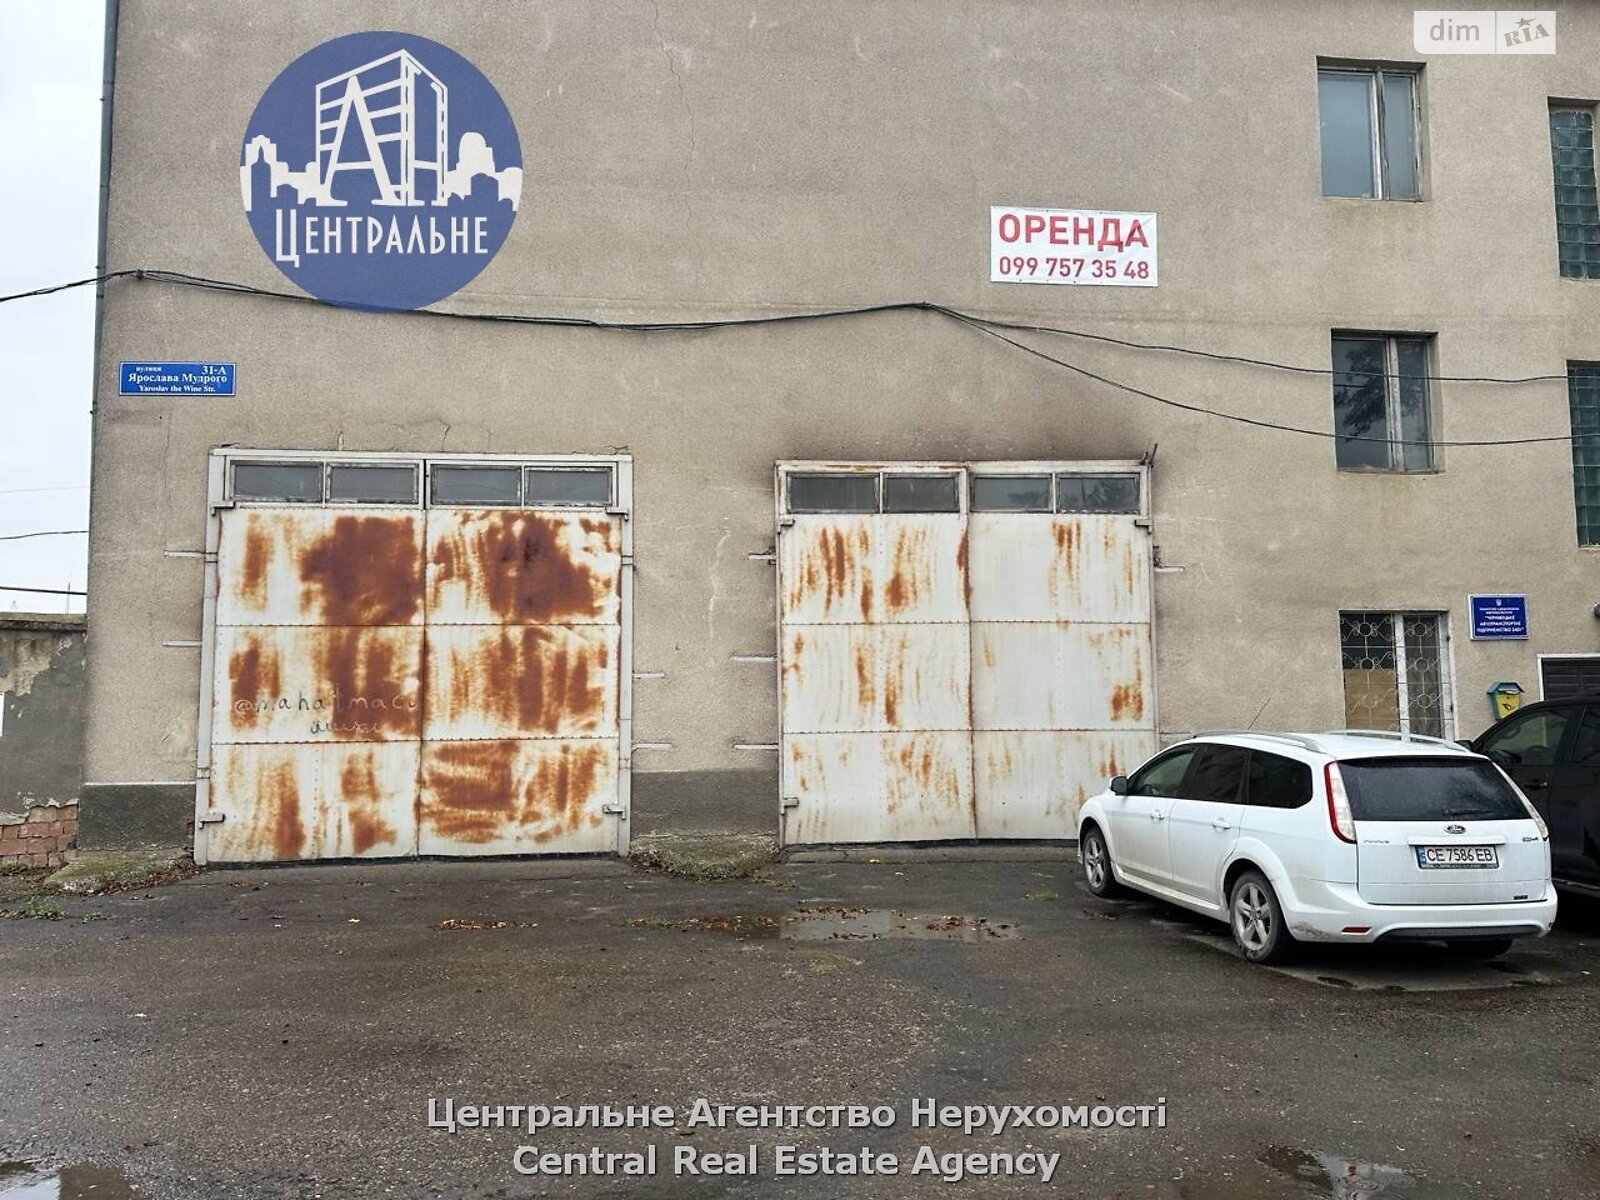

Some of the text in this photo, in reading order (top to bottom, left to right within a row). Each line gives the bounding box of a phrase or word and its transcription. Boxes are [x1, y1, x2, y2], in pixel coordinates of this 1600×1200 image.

[999, 213, 1149, 253] ОРЕНДА
[999, 256, 1149, 279] 099 757 35 48
[201, 365, 227, 375] 31-А
[128, 373, 228, 384] Ярослава Мудрого
[1427, 848, 1445, 862] CE
[1446, 848, 1475, 862] 7586
[1475, 848, 1493, 862] EB
